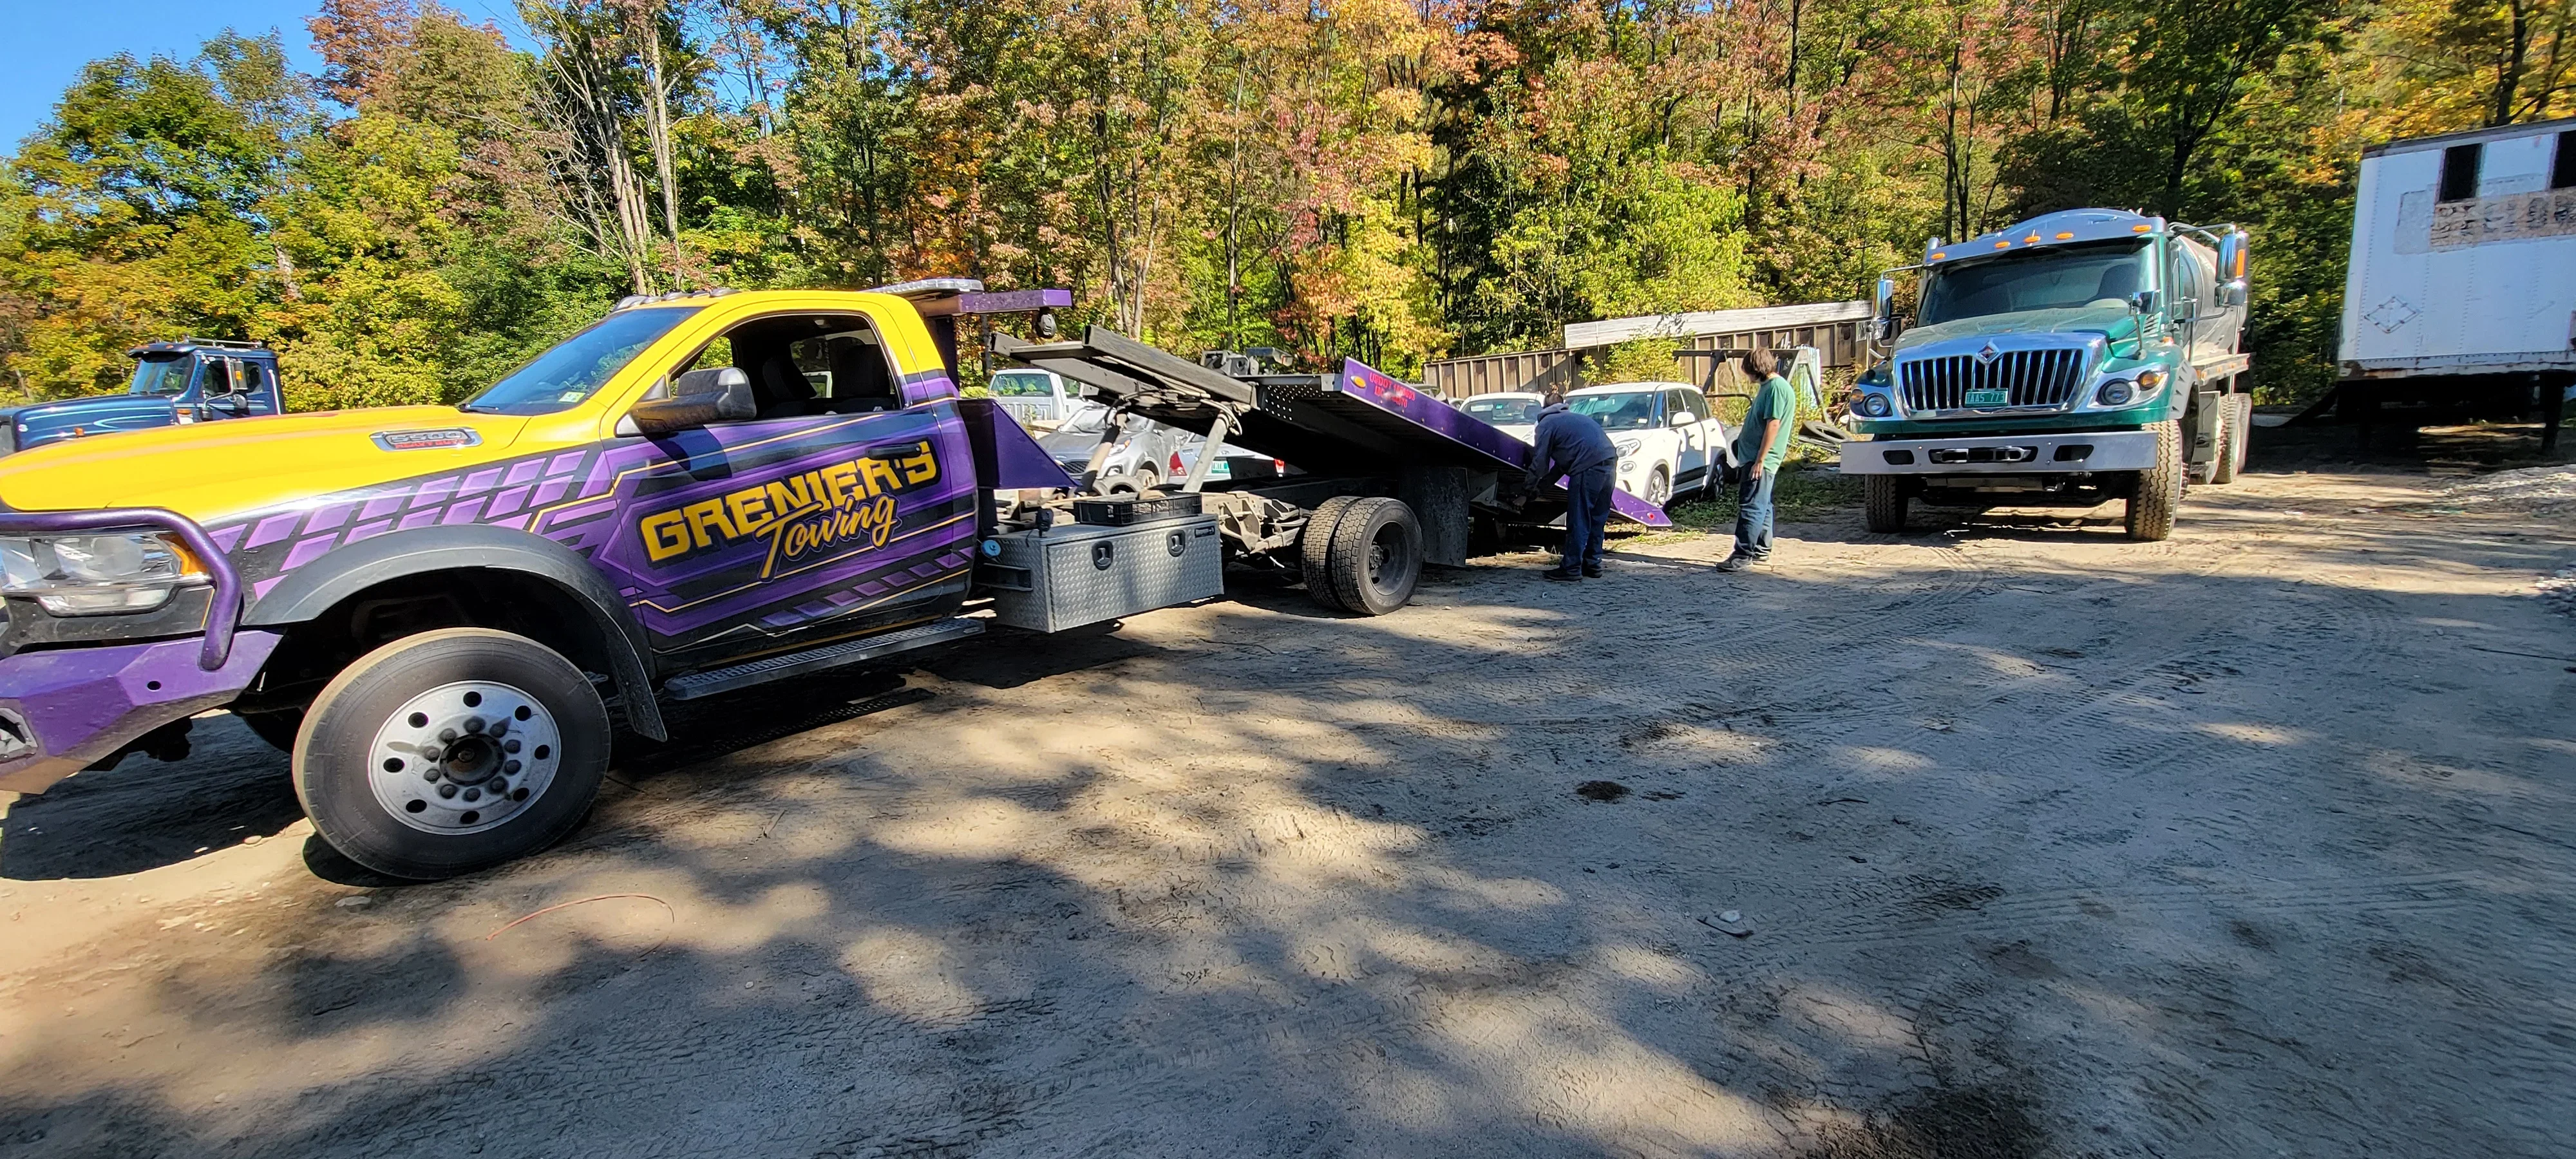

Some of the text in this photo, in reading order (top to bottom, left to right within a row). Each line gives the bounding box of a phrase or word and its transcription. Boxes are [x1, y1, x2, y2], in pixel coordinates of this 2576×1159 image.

[391, 432, 462, 442] 5500
[641, 441, 936, 561] GRENIER'S
[754, 495, 896, 580] Towing
